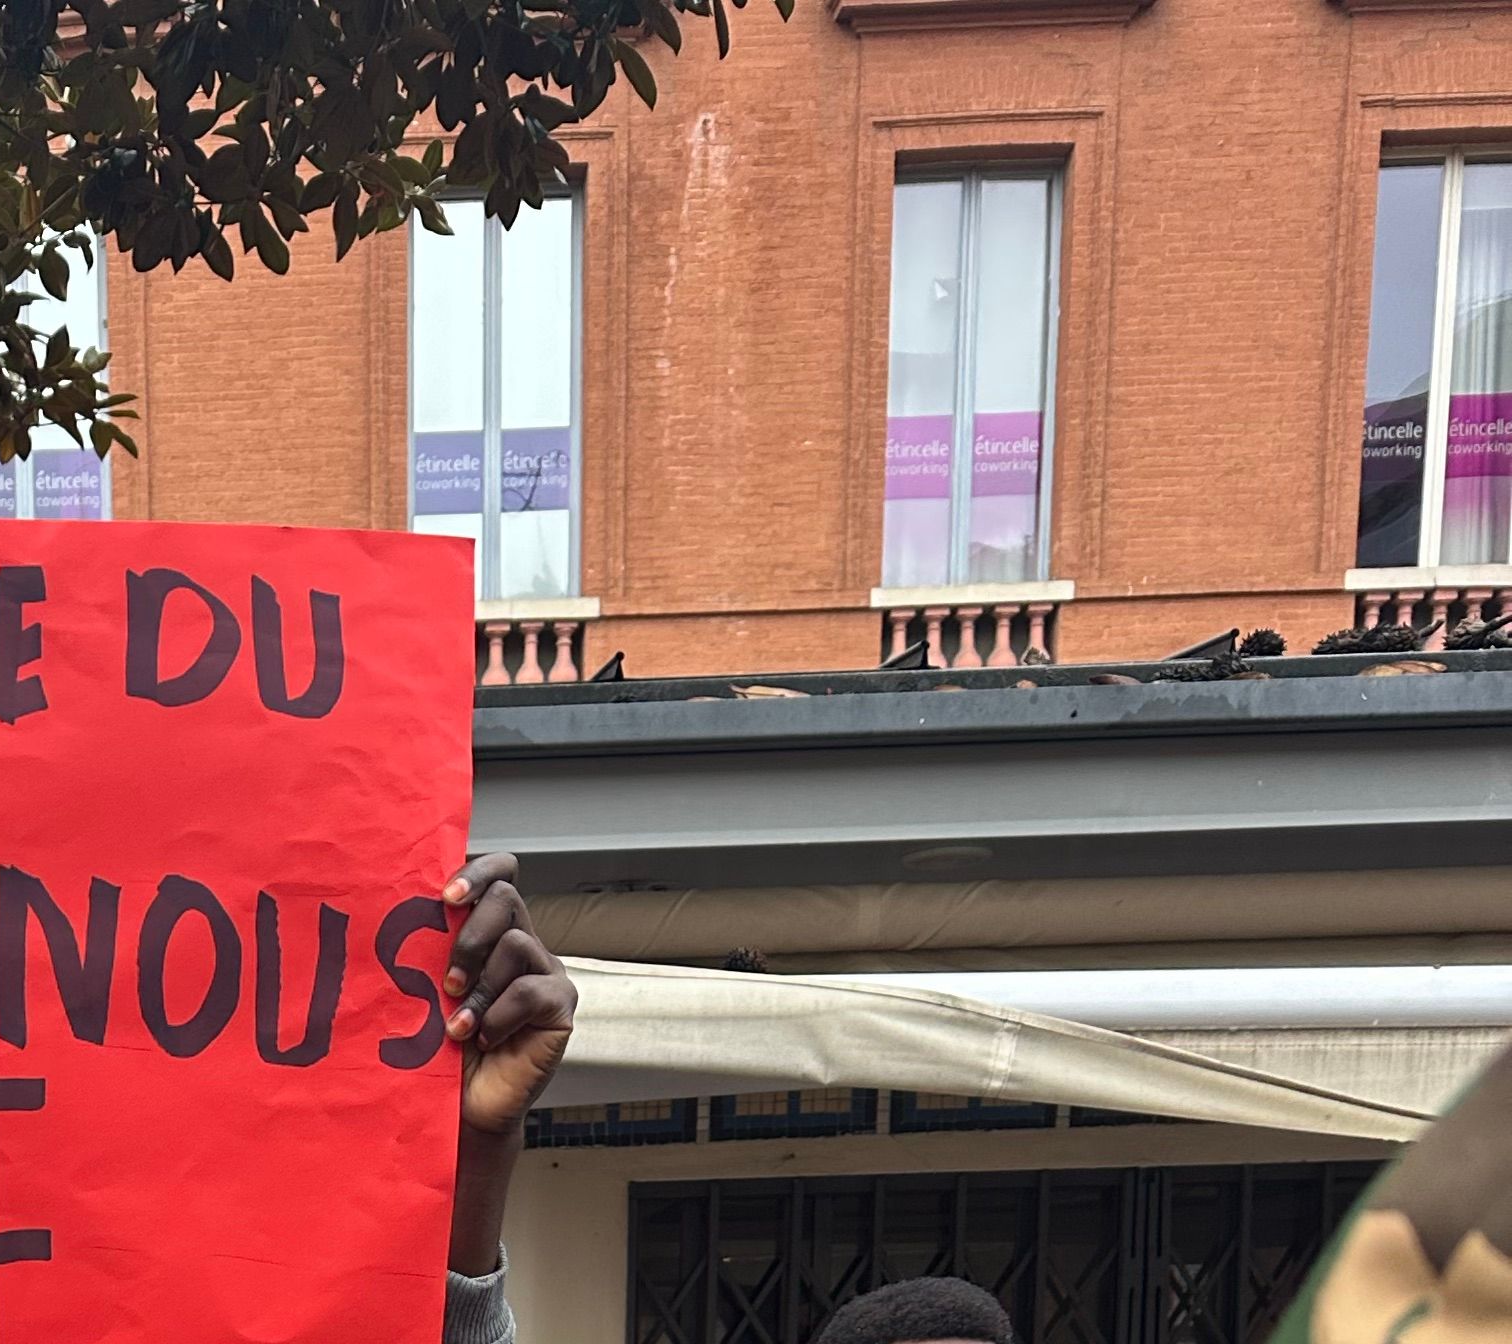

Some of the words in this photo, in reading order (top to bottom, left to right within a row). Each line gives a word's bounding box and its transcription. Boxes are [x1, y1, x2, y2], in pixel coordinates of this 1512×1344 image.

[885, 439, 950, 458] étincelle
[975, 435, 1039, 455] étincelle
[1363, 443, 1423, 459] oworking
[1448, 441, 1512, 455] coworking
[416, 454, 481, 473] étincelle
[974, 459, 1038, 474] coworking
[36, 470, 99, 490] étincelle
[416, 476, 481, 492] coworking
[37, 493, 100, 508] coworking
[126, 568, 345, 719] DU
